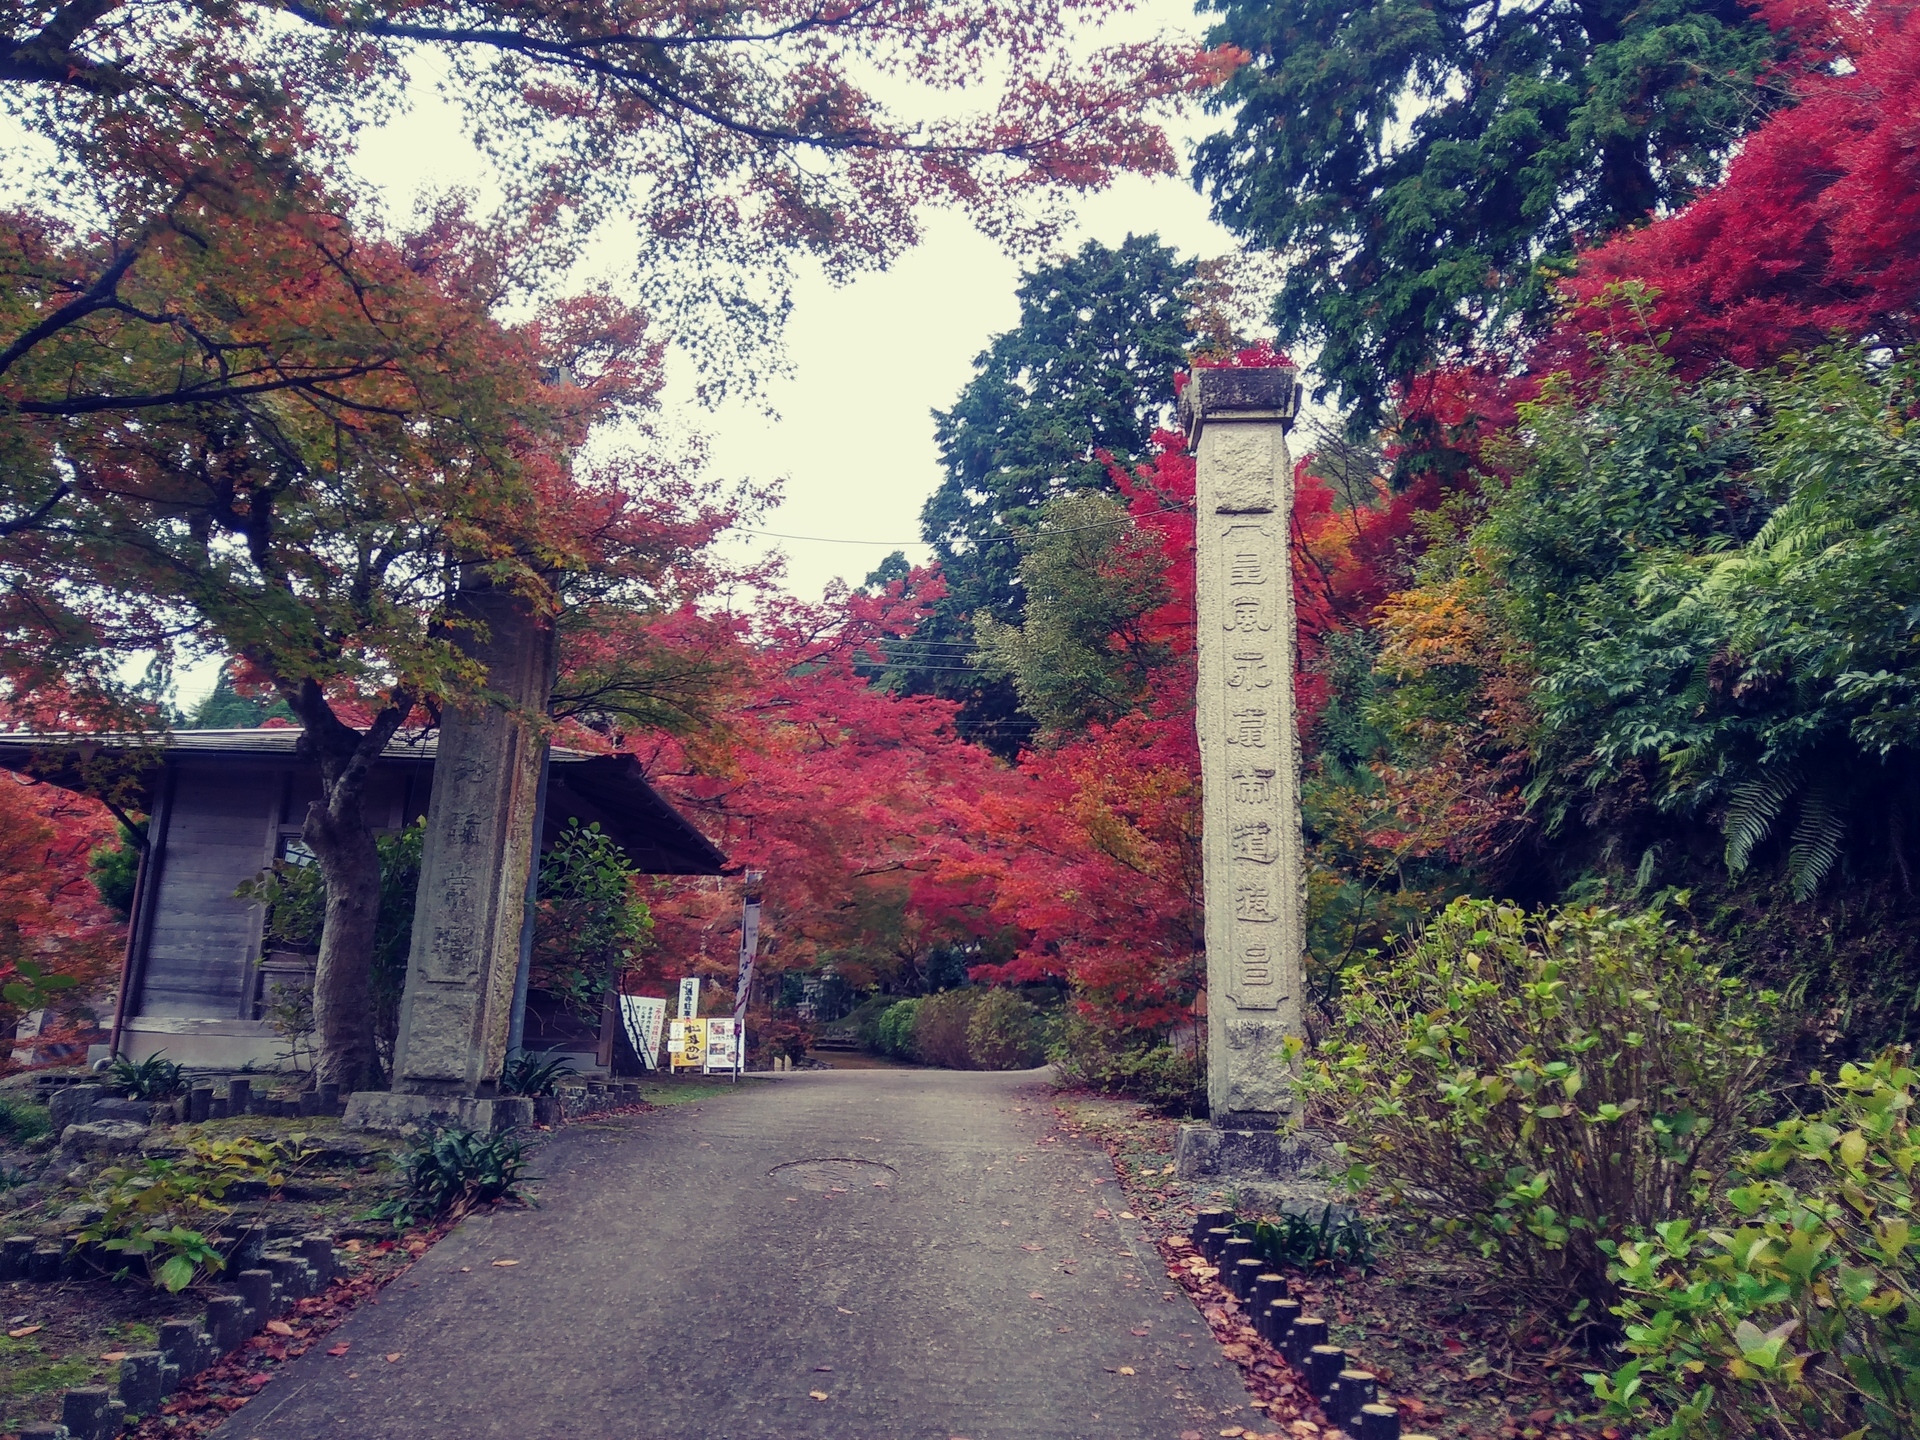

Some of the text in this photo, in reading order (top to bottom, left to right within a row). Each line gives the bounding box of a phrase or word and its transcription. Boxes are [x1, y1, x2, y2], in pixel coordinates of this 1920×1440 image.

[682, 980, 694, 1022] 円通寺駐車
